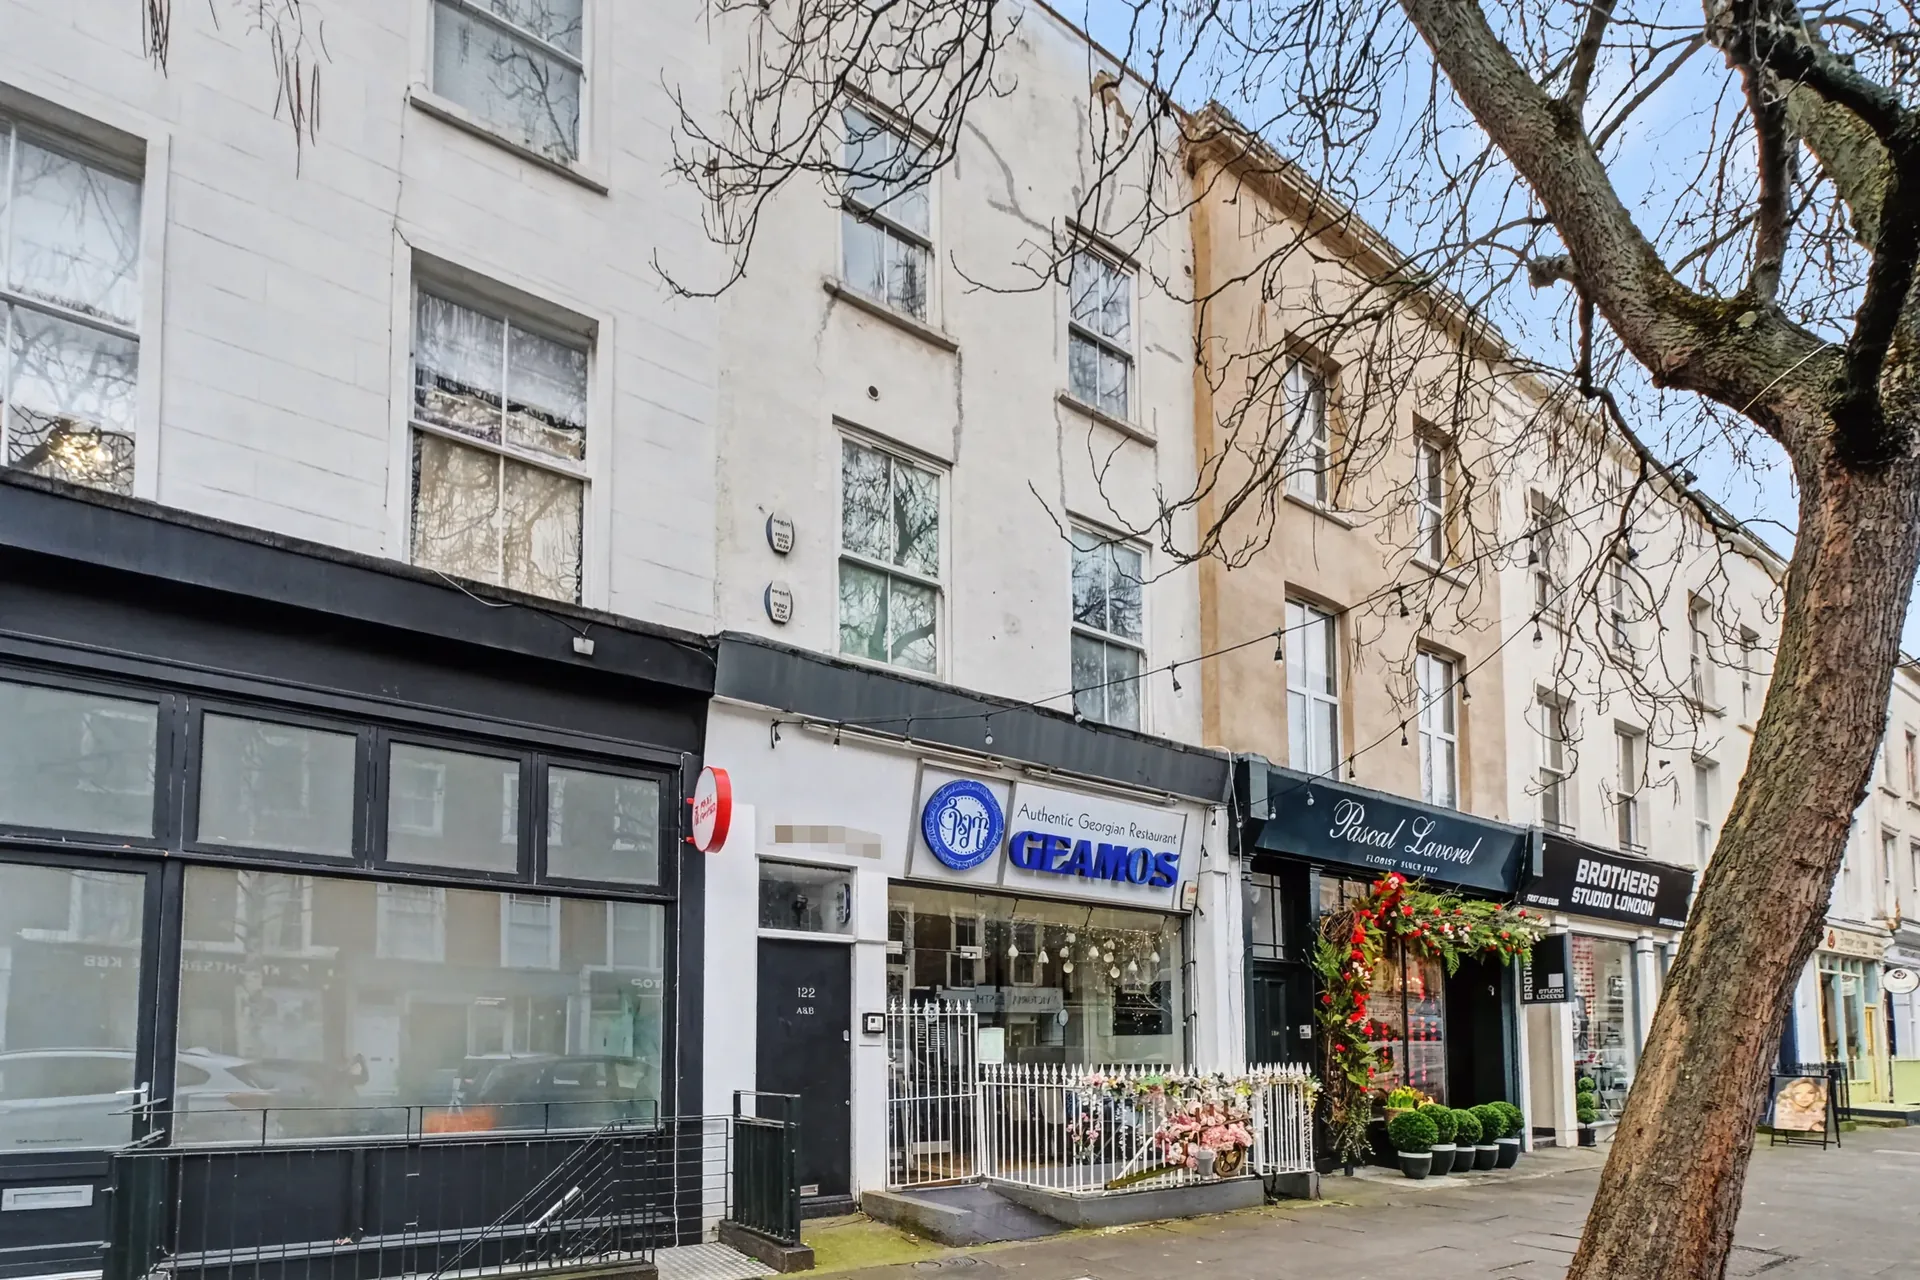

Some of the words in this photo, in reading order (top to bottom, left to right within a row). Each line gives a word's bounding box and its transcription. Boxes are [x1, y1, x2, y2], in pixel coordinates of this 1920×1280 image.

[1017, 803, 1074, 828] Authentic
[1078, 812, 1126, 838] Georgian
[1129, 823, 1178, 845] Restaurant
[1330, 799, 1405, 849] Pascal
[1404, 816, 1482, 865] Lavorel
[1009, 831, 1179, 888] GEAMOS
[1575, 858, 1661, 898] BROTHERS
[1571, 886, 1613, 909] STUDIO
[1613, 893, 1656, 917] LONDON
[796, 1006, 815, 1015] A&B
[797, 987, 816, 998] 122
